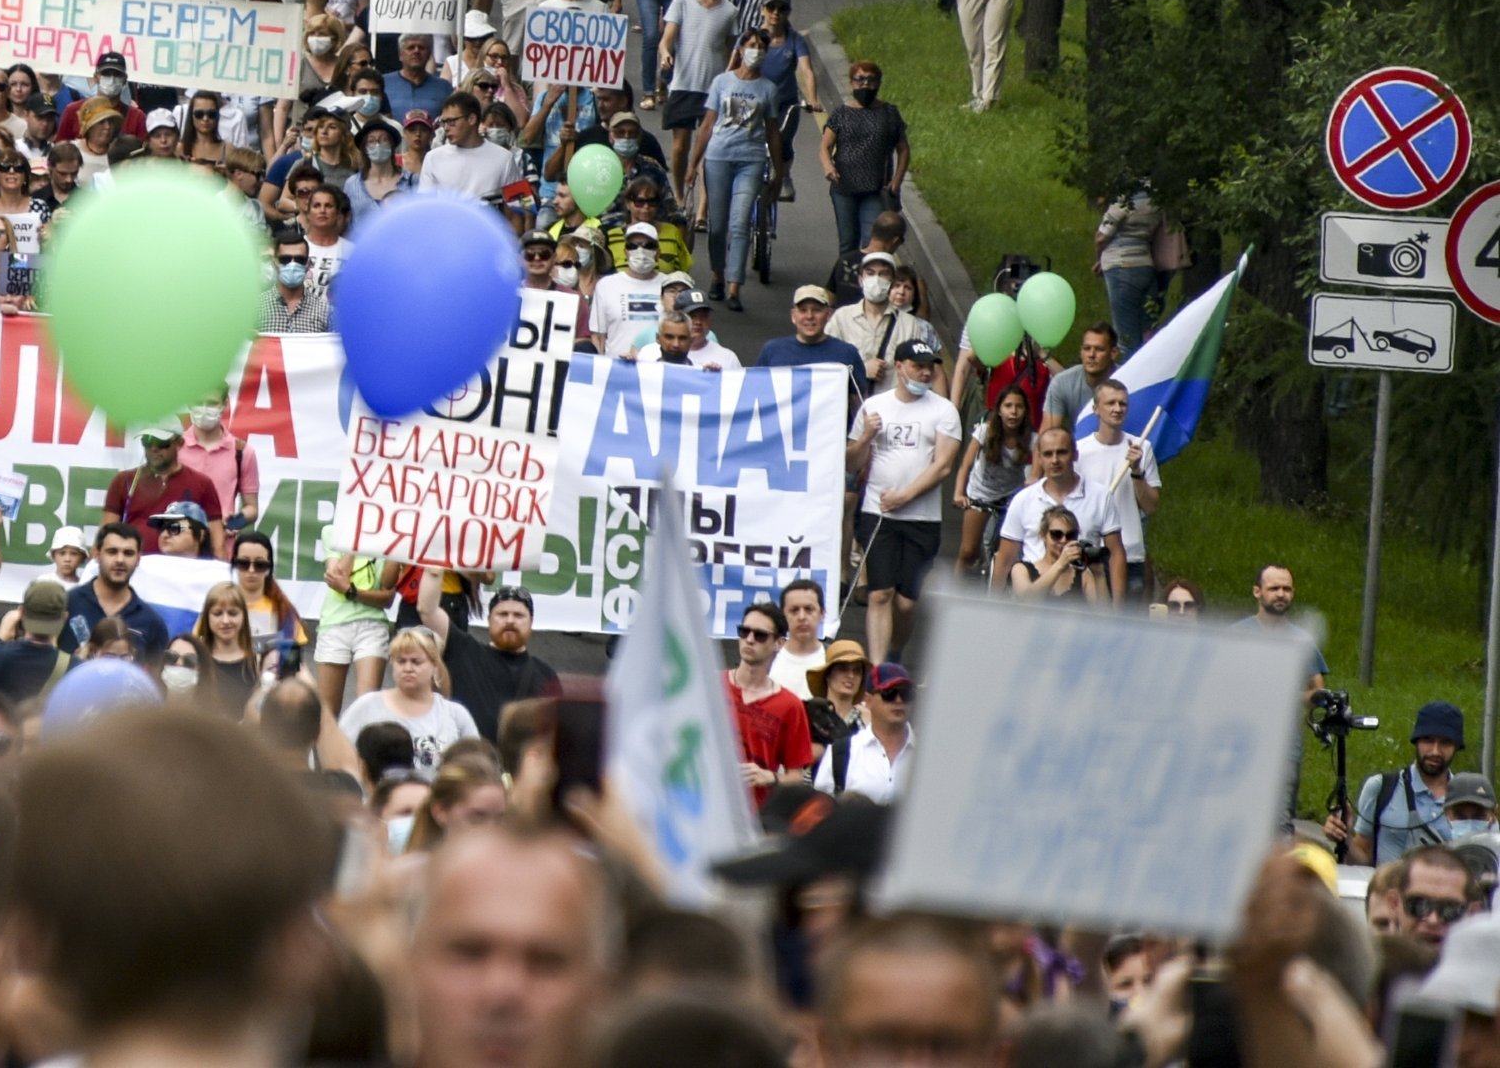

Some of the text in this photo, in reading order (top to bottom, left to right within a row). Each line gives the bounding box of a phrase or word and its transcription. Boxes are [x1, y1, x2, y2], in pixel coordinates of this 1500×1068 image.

[527, 10, 629, 50] СВОБОДУ
[152, 38, 297, 87] ОБИДНО!
[526, 42, 625, 85] ФУРГАЛУ
[353, 416, 545, 484] БЕЛАРУСЬ
[893, 425, 913, 440] 27
[346, 459, 549, 527] ХАБАРОВСК
[353, 500, 525, 571] РЯДОМ
